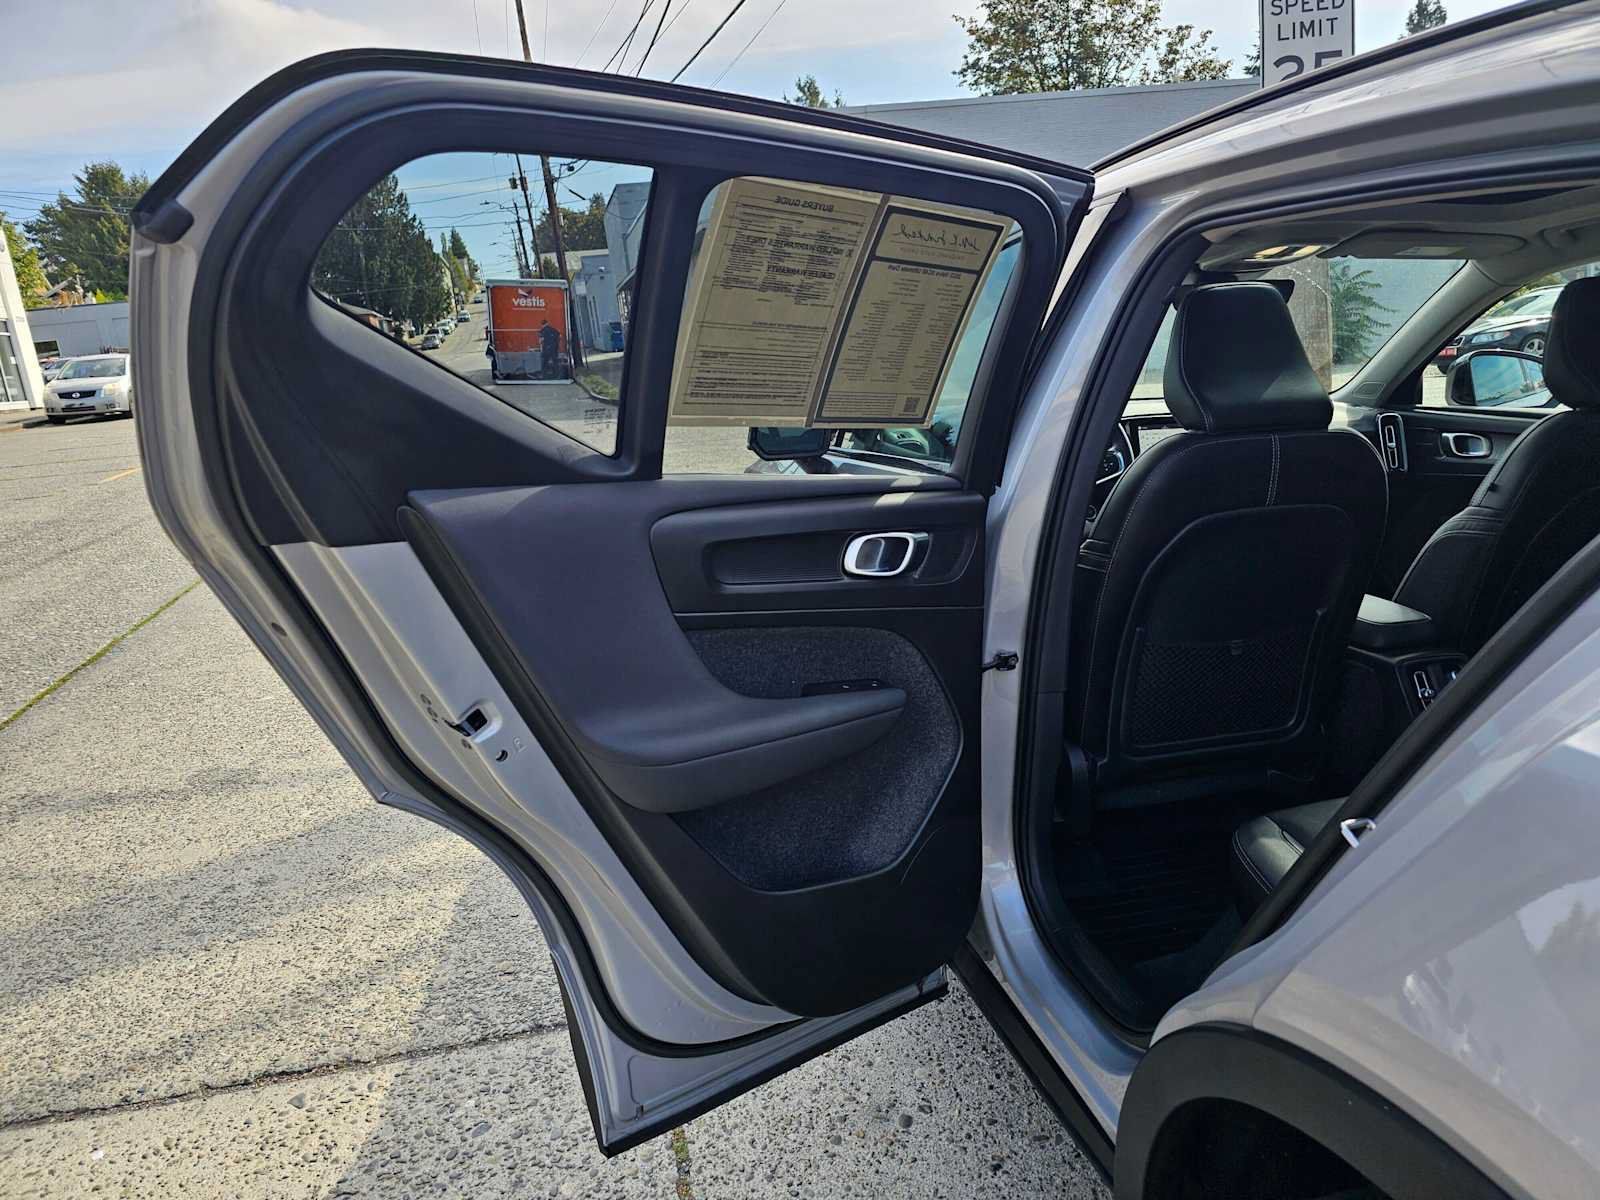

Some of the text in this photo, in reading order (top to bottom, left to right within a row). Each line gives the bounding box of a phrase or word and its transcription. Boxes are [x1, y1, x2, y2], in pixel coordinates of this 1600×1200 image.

[1271, 0, 1344, 16] SPEED
[1277, 17, 1338, 41] LIMIT
[512, 296, 545, 307] vestis
